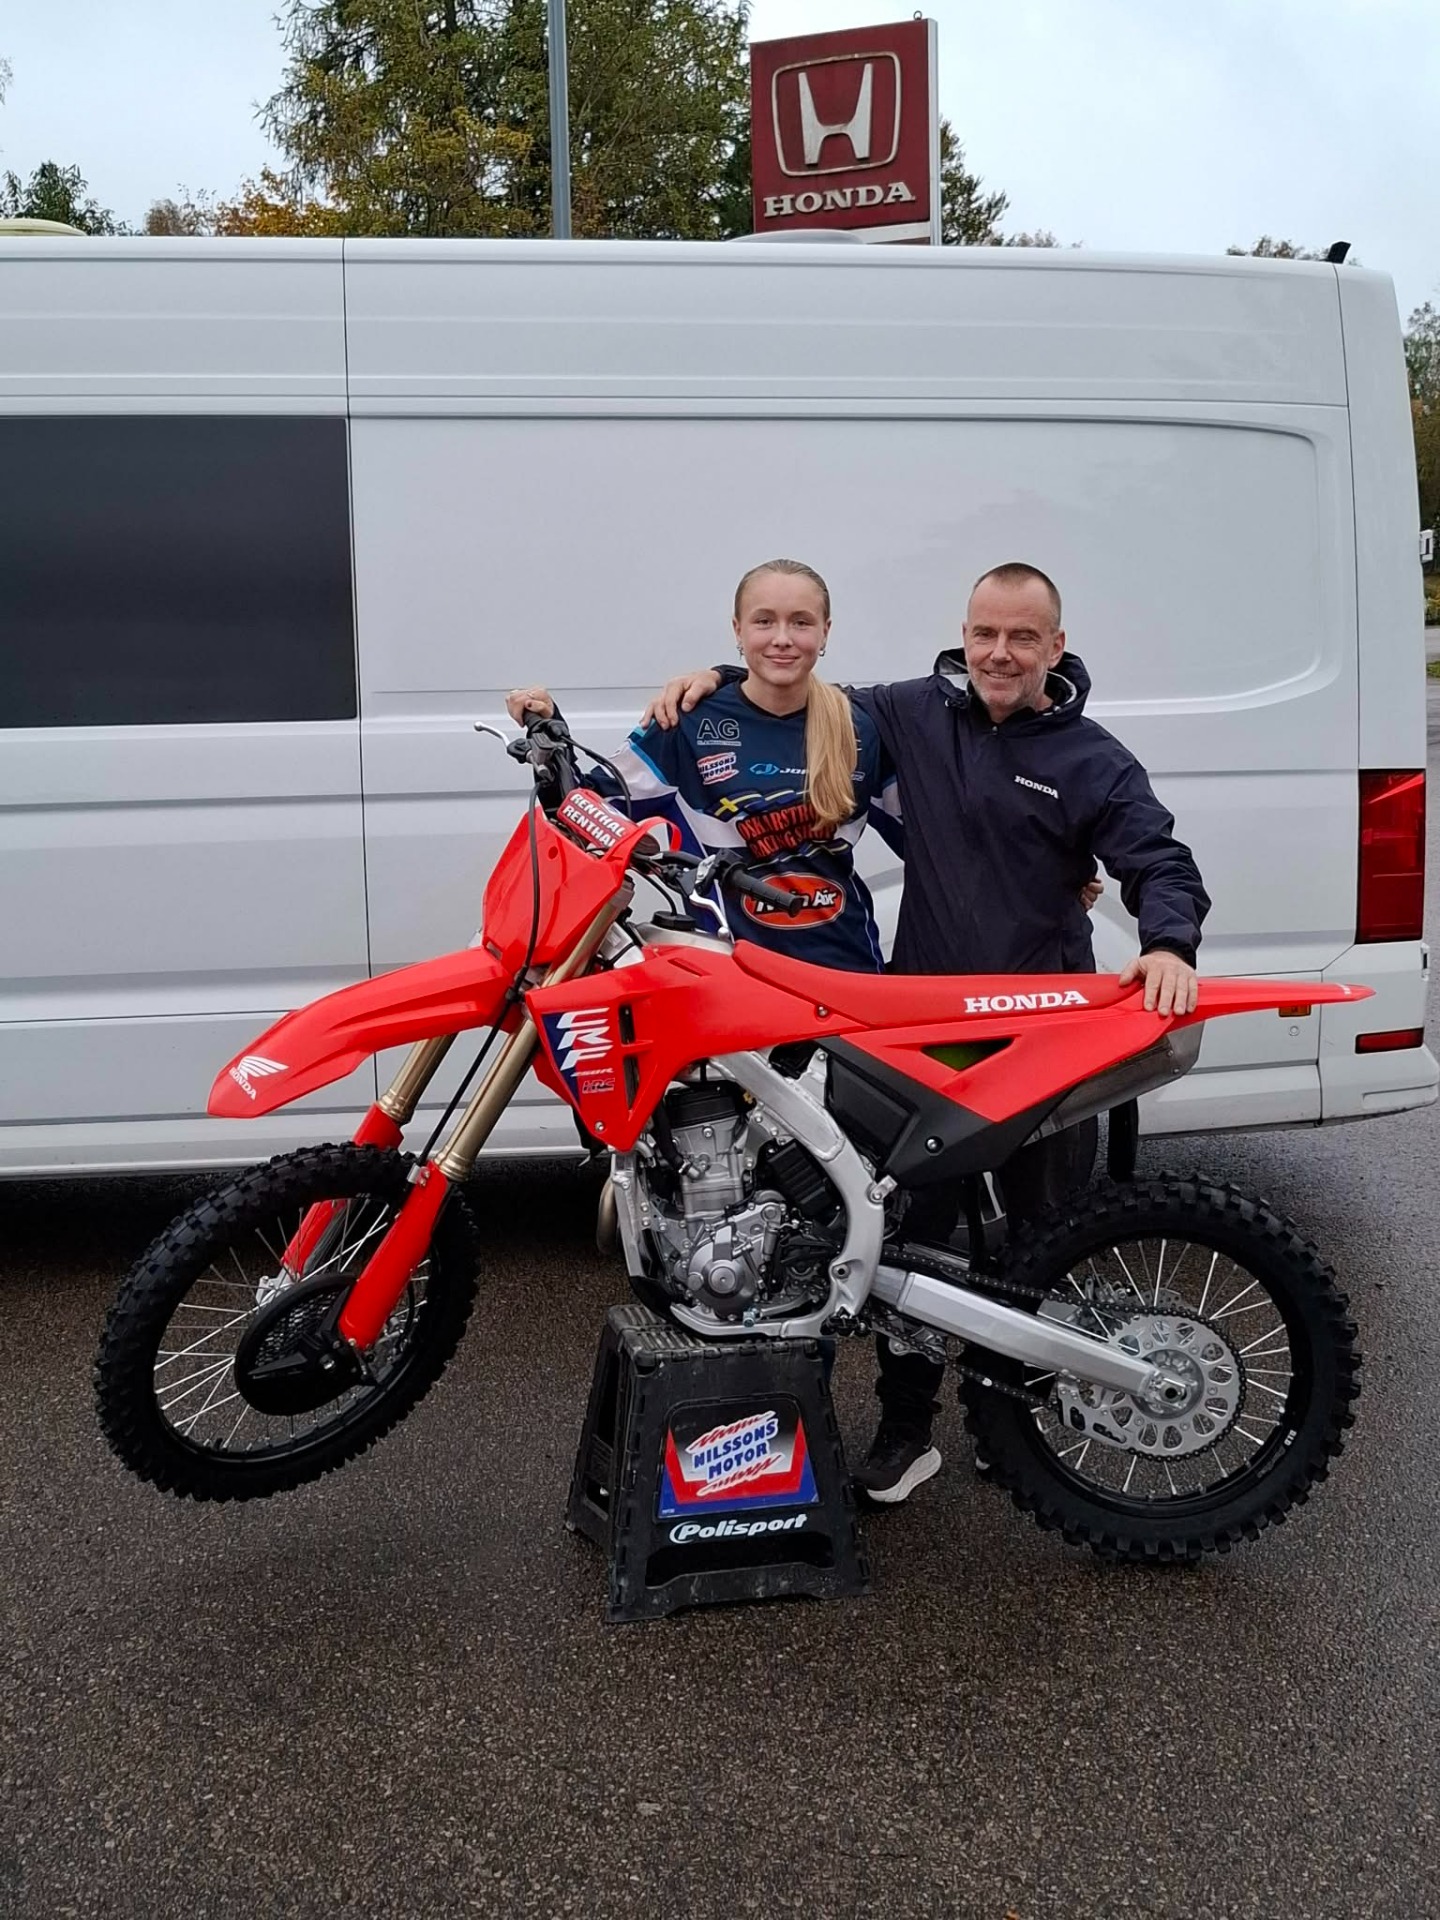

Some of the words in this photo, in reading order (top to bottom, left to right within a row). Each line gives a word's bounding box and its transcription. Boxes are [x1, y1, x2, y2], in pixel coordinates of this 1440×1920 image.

[763, 181, 915, 217] HONDA
[697, 718, 740, 740] AG
[1014, 775, 1059, 799] HONDA
[570, 793, 627, 837] RENTHAL
[812, 889, 837, 907] Air
[964, 990, 1089, 1013] HONDA
[229, 1066, 257, 1100] HONDA
[694, 1420, 776, 1468] NILSSONS
[708, 1442, 767, 1480] MOTOR
[671, 1514, 807, 1543] Polisport
